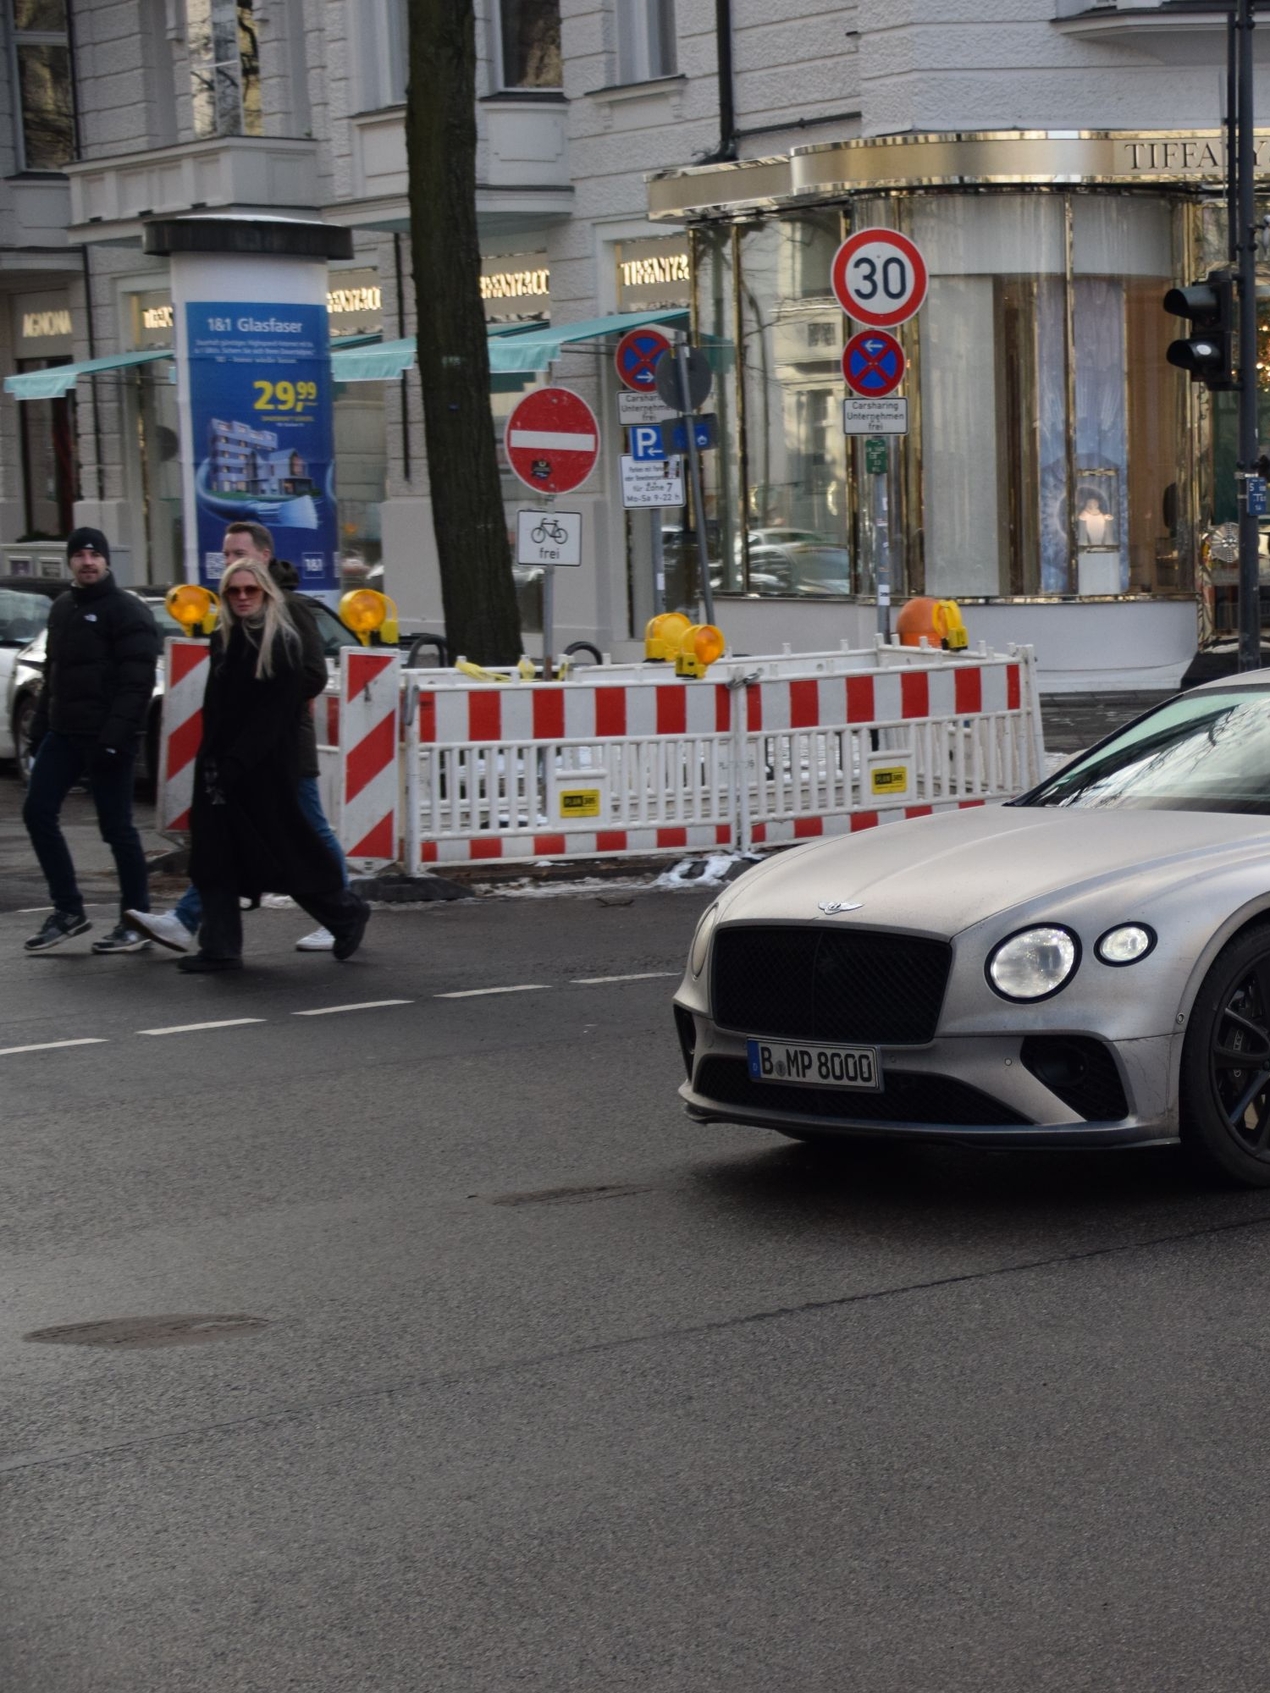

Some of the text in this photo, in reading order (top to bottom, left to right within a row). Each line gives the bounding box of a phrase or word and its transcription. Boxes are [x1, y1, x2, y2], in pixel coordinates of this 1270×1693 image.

[620, 253, 690, 286] TIFFANY&
[853, 256, 907, 300] 30
[208, 317, 303, 333] 1&1 Glasfaser
[625, 394, 661, 403] Carshar
[852, 401, 899, 412] Carsharing
[846, 411, 905, 420] Unternehmen
[867, 422, 883, 431] frei
[636, 428, 657, 457] P
[645, 482, 665, 492] Zone
[666, 482, 673, 493] 7
[626, 494, 651, 502] Mo-Sa
[653, 493, 672, 502] 9-22
[539, 547, 560, 559] frei
[761, 1046, 873, 1082] B MP 8000
